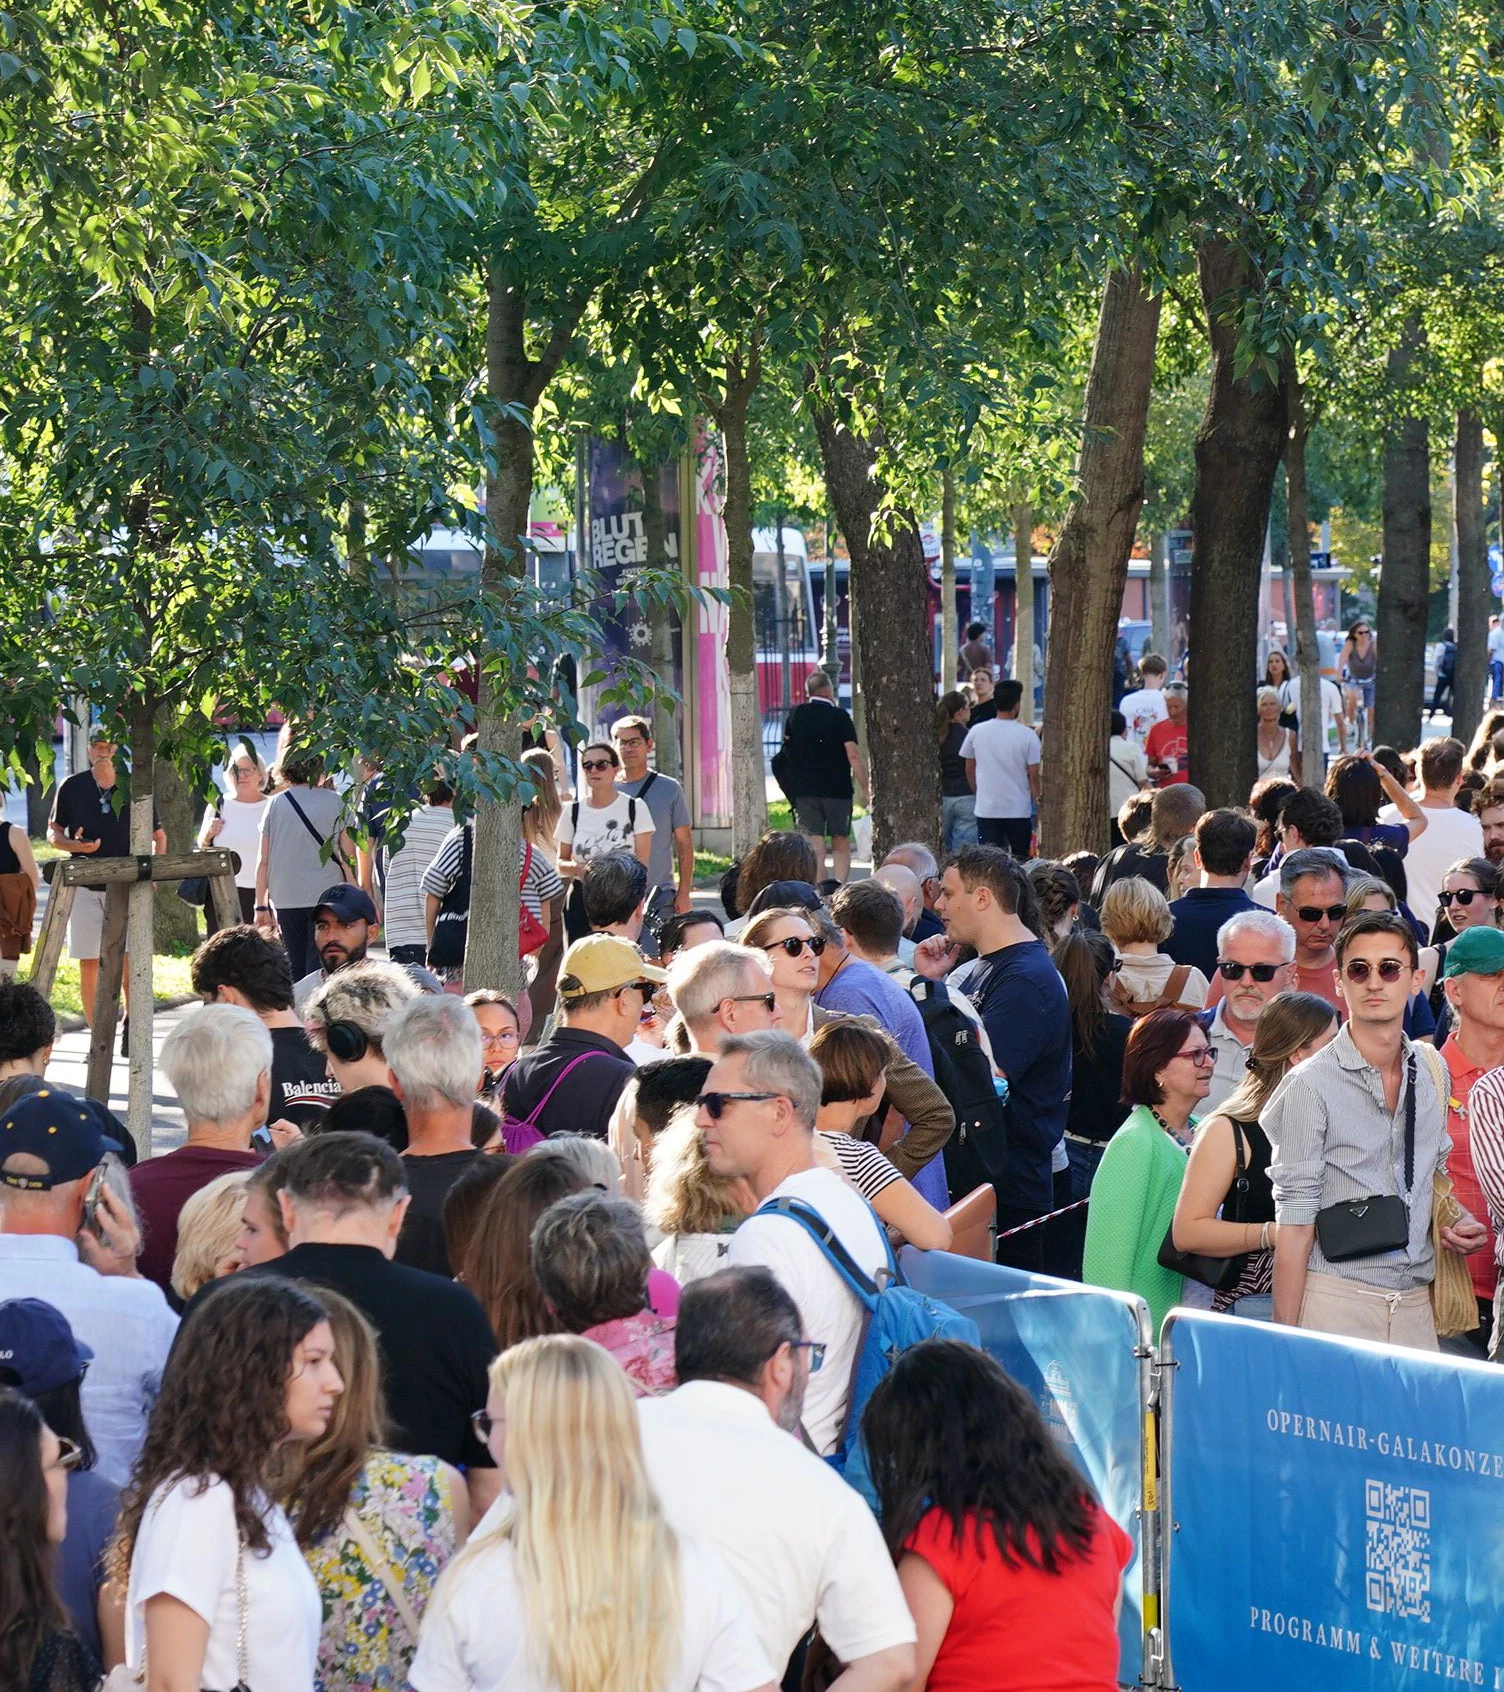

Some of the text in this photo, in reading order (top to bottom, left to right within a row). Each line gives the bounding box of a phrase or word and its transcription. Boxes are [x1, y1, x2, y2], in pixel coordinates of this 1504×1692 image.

[592, 512, 643, 544] BLUT
[281, 1079, 341, 1097] Balencia
[1250, 1606, 1361, 1655] PROGRAMM
[1369, 1636, 1382, 1660] &
[1390, 1641, 1484, 1686] WEITERE
